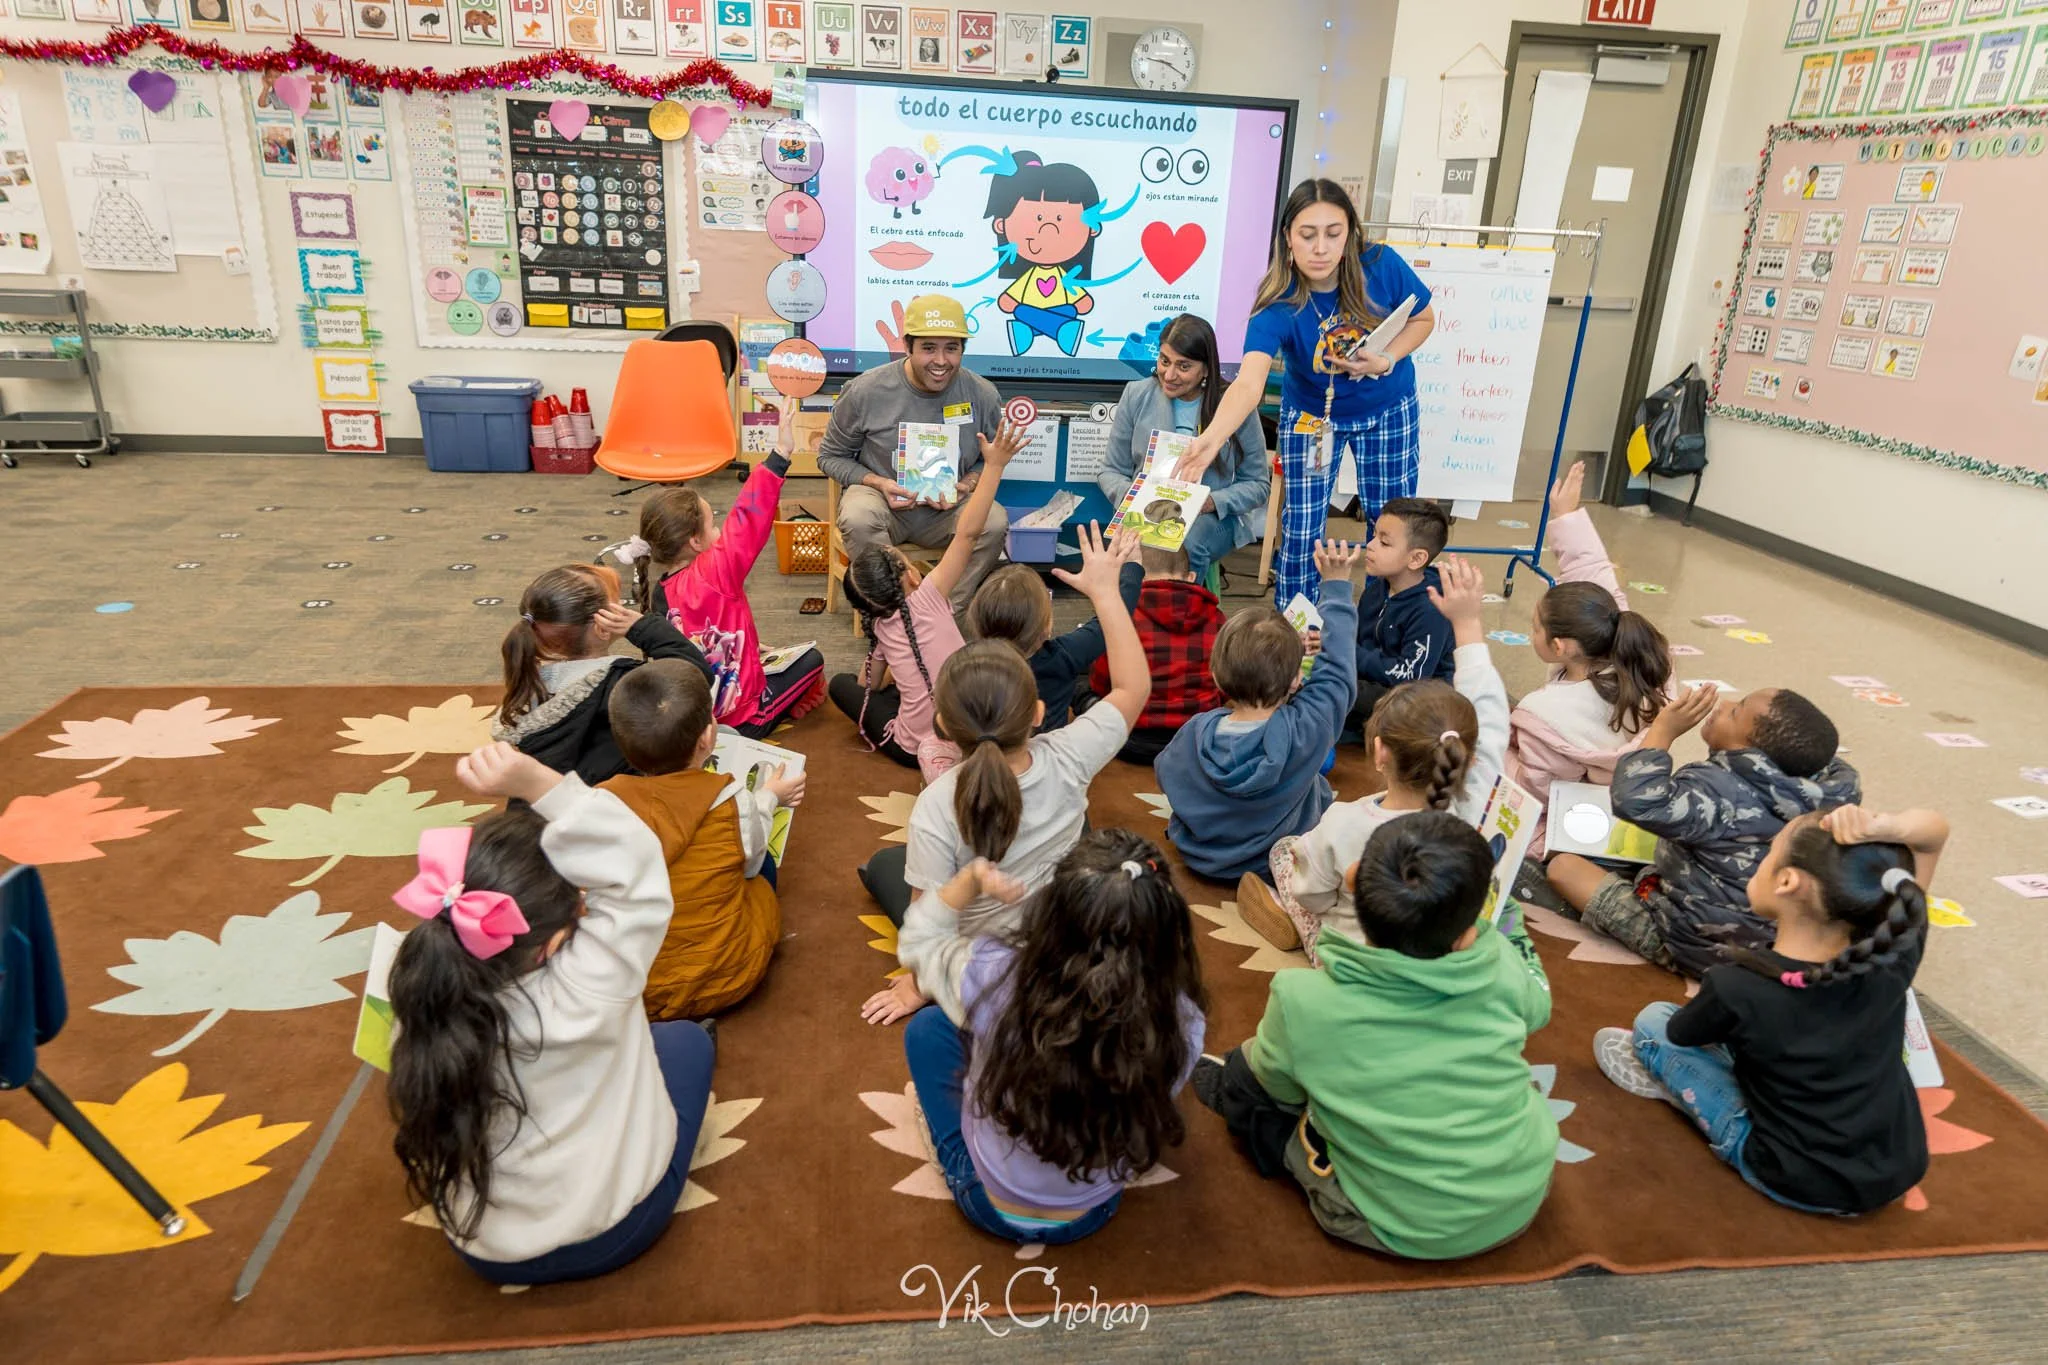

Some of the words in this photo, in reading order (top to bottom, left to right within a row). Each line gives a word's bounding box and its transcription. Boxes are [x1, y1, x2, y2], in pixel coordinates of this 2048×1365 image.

[675, 7, 694, 20] rr
[724, 5, 746, 24] Ss
[775, 7, 795, 26] Tt
[821, 6, 847, 29] Uu
[869, 12, 895, 32] Vv
[914, 16, 944, 32] Ww
[964, 17, 991, 37] Xx
[1011, 19, 1038, 44] Yy
[1059, 23, 1083, 42] Zz
[1162, 31, 1170, 41] 12
[1183, 47, 1188, 55] 2
[1185, 60, 1190, 69] 3
[1936, 55, 1957, 76] 14
[1988, 49, 2009, 71] 15
[1847, 65, 1865, 85] 12
[1890, 61, 1908, 81] 13
[1171, 81, 1177, 90] 5
[899, 95, 950, 118] todo
[958, 98, 978, 119] el
[987, 104, 1062, 128] cuerpo
[1071, 106, 1198, 133] escuchando
[539, 125, 546, 133] 6
[1447, 169, 1474, 182] EXIT
[1145, 192, 1161, 201] ojos
[1163, 193, 1185, 201] estan
[1187, 194, 1219, 203] mirando
[870, 226, 879, 234] El
[881, 227, 903, 235] cebro
[905, 228, 924, 236] está
[927, 230, 964, 238] enfocado
[867, 276, 890, 285] labios
[892, 278, 914, 286] estan
[916, 279, 950, 287] cerrados
[1142, 291, 1150, 299] el
[1152, 292, 1181, 300] corazon
[1765, 287, 1776, 308] 6
[1153, 303, 1187, 311] cuidando
[925, 310, 940, 319] DO
[926, 319, 957, 329] GOOD.
[1023, 366, 1040, 375] pies
[1042, 367, 1081, 375] tranquilos
